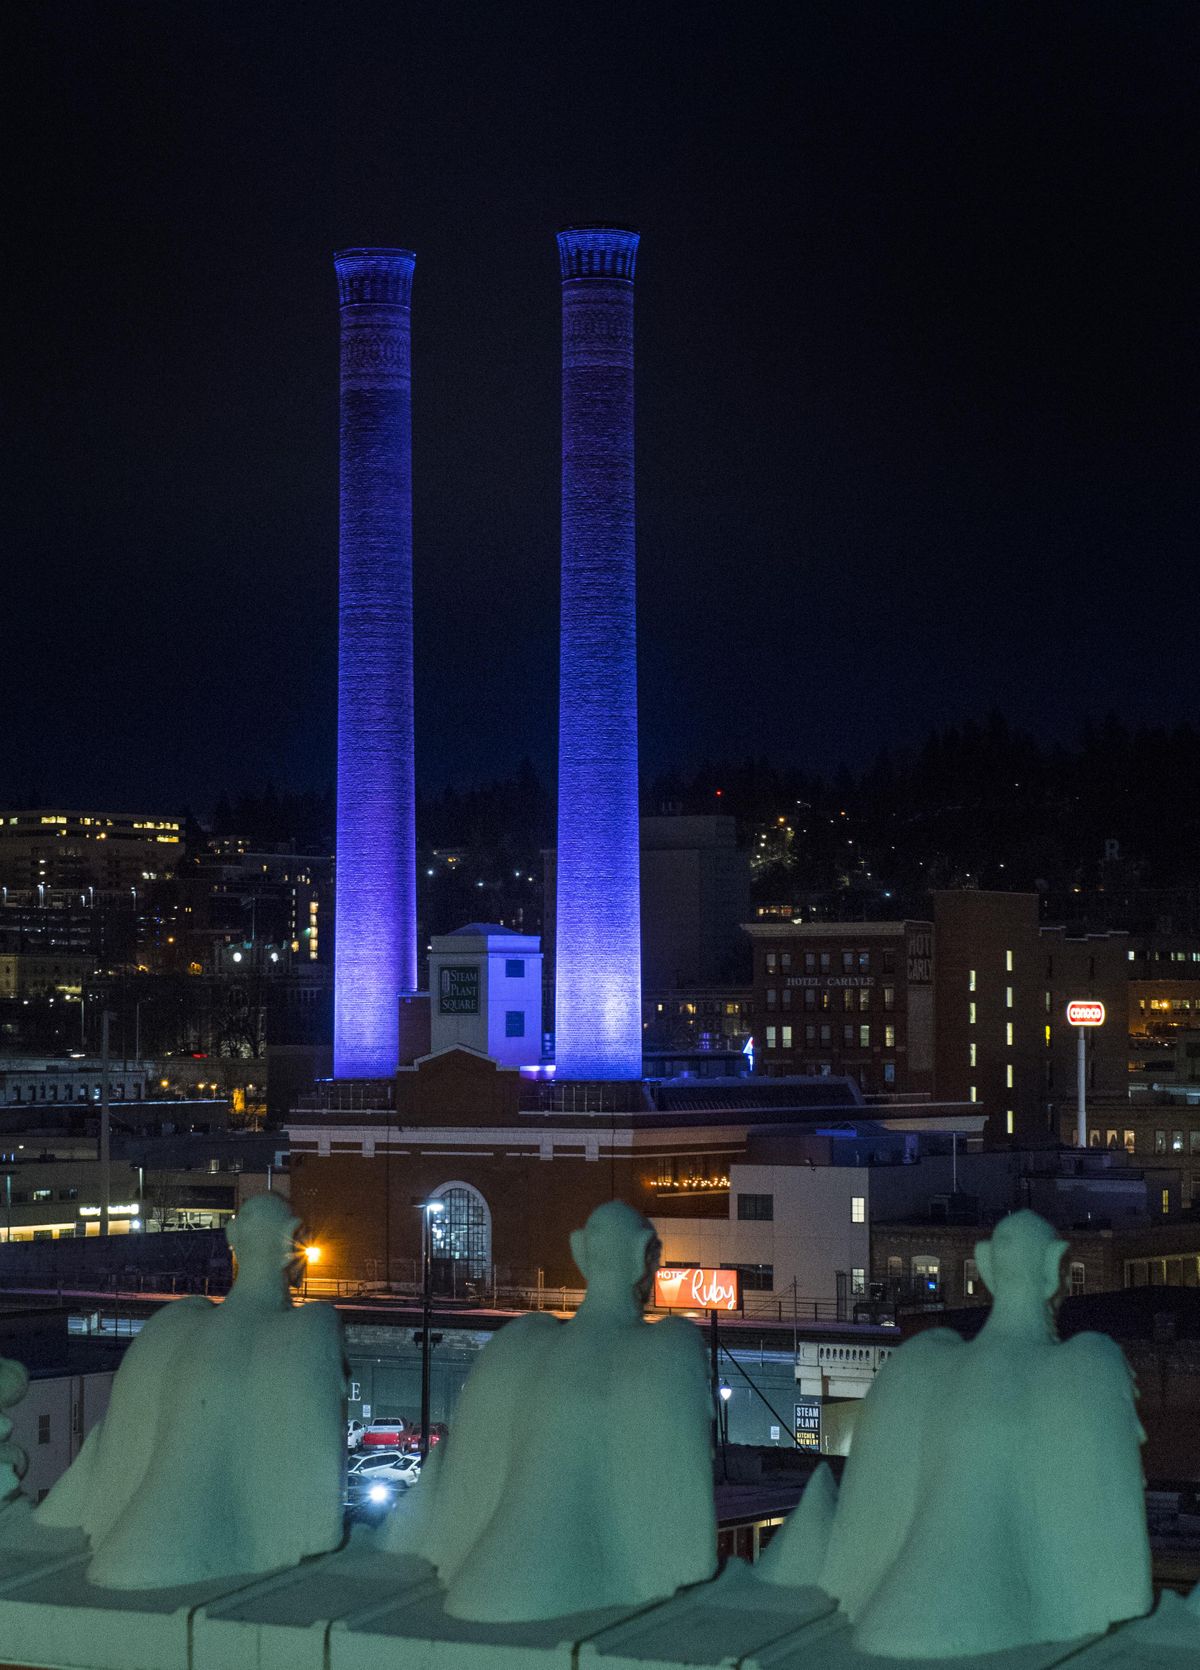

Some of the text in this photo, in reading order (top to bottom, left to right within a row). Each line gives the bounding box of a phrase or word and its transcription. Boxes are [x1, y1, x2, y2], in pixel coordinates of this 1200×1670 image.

[450, 970, 477, 982] STEAM
[787, 977, 874, 986] HOTEL CARLYLE
[451, 984, 476, 996] PLANT
[442, 998, 477, 1012] SQUARE
[691, 1269, 736, 1310] Ruby
[796, 1406, 819, 1417] STEAM
[797, 1418, 819, 1428] PLANT
